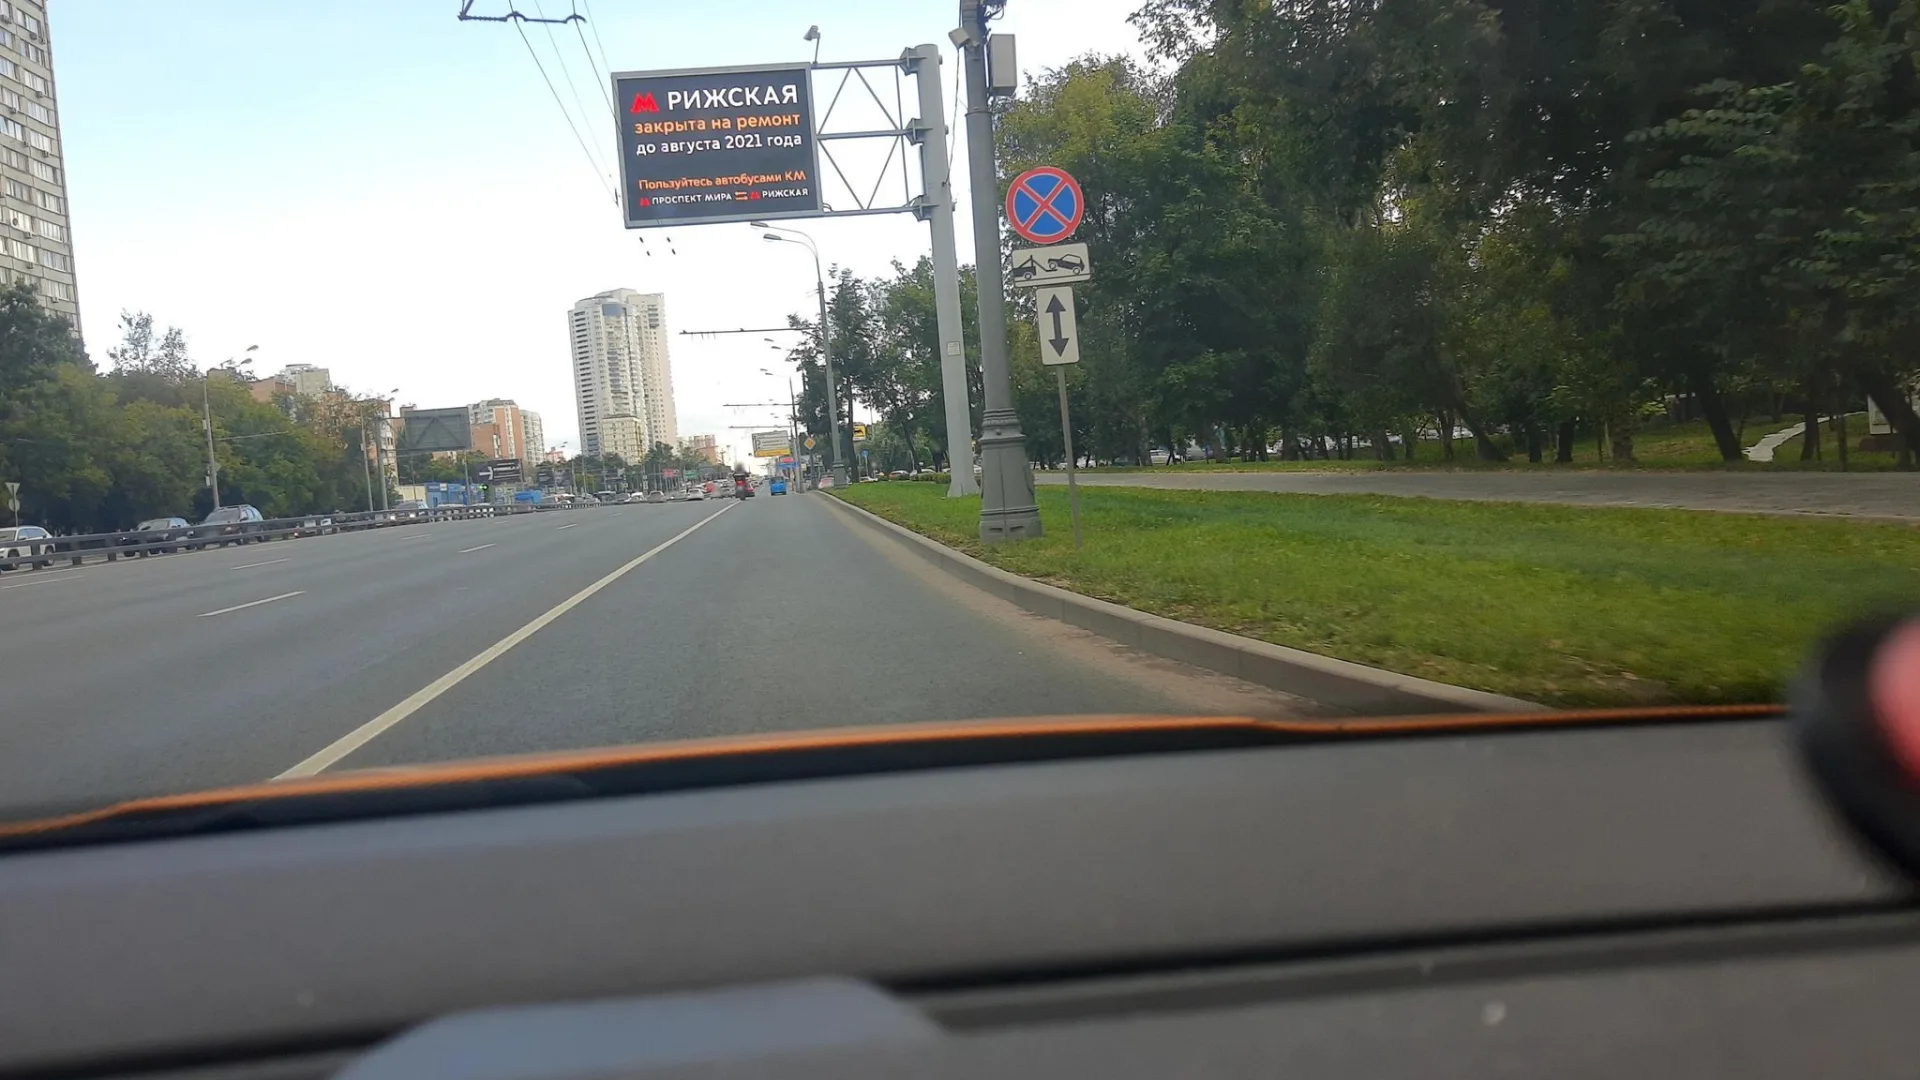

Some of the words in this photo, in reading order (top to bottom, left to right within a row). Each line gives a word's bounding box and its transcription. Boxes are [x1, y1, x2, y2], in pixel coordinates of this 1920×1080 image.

[667, 84, 798, 110] РИЖСКАЯ
[634, 118, 706, 134] закрыта
[711, 119, 731, 129] на
[737, 113, 800, 131] ремонт
[636, 142, 656, 156] до
[660, 137, 720, 154] августа
[724, 134, 762, 149] 2021
[767, 134, 802, 148] года
[638, 175, 712, 190] Пользуйтесь
[715, 170, 782, 188] автобусами
[784, 169, 806, 181] КМ
[652, 194, 702, 205] ПРОСПЕКТ
[704, 192, 732, 202] МИРА
[762, 187, 809, 198] РИЖСКАЯ
